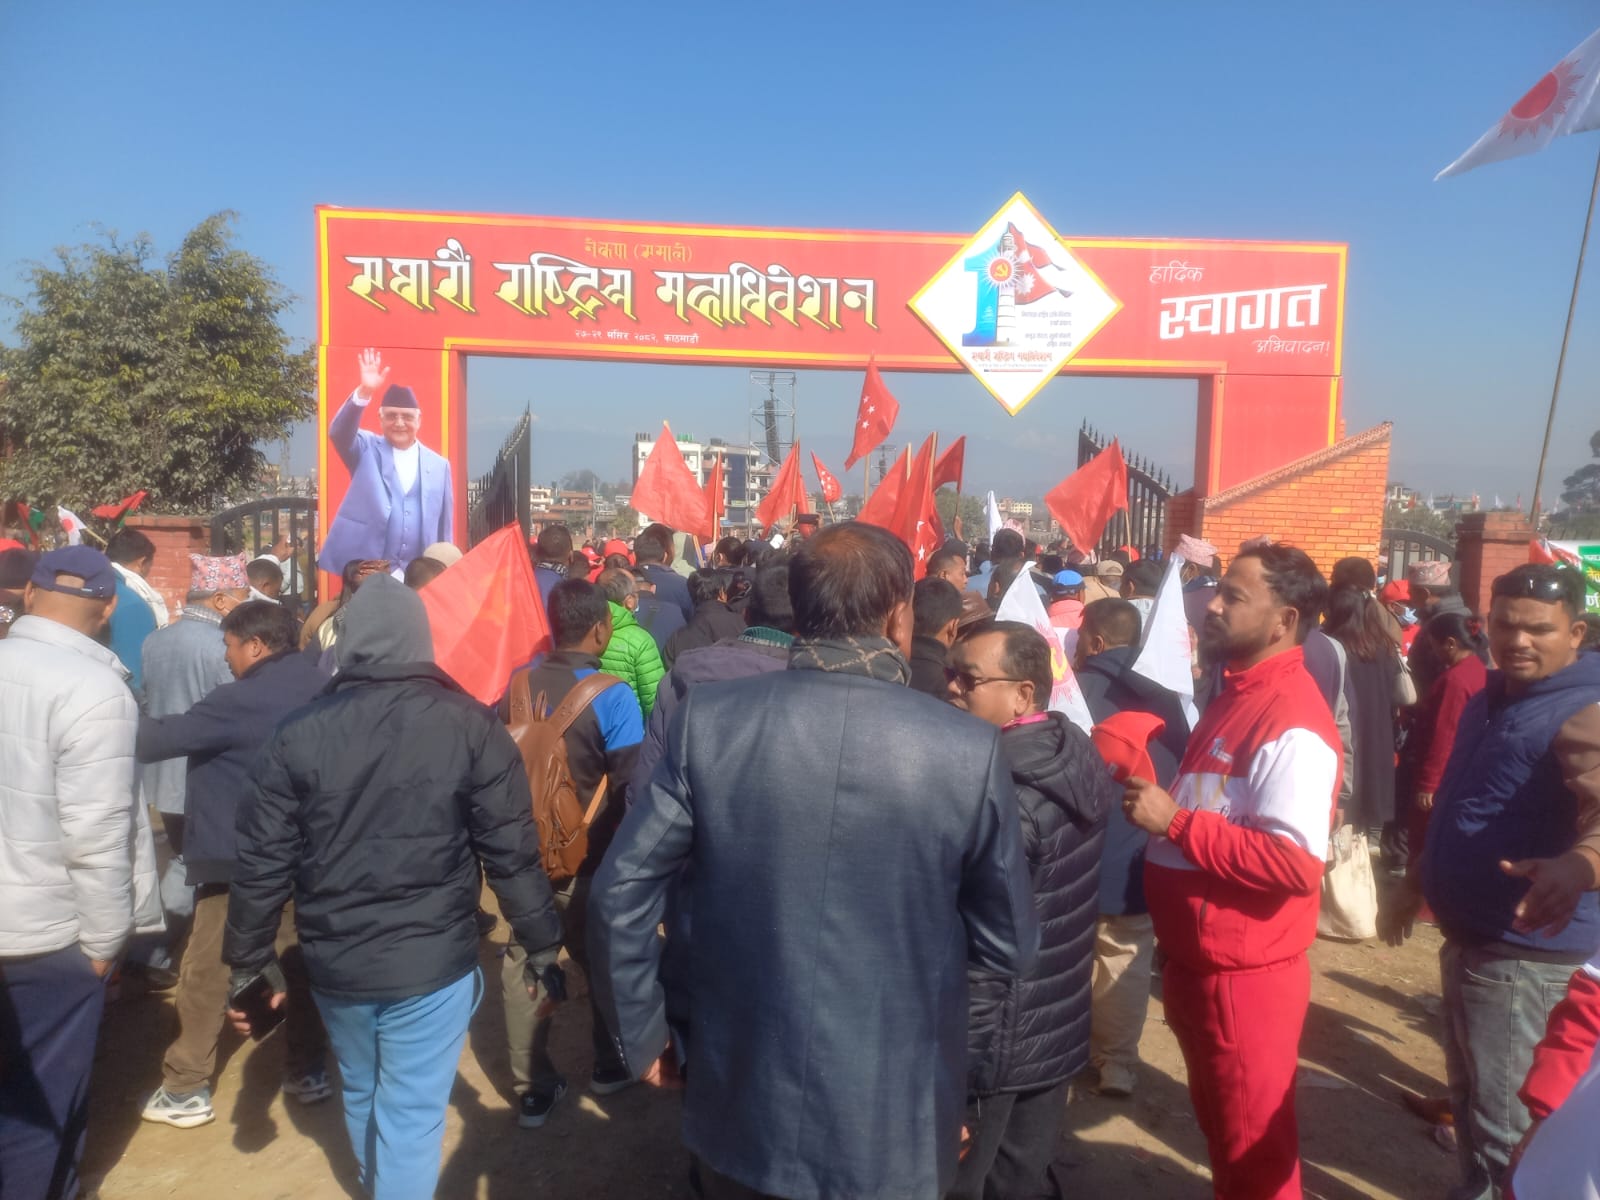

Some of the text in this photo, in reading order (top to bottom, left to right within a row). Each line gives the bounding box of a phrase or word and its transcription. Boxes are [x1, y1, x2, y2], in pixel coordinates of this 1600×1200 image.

[491, 251, 638, 321] राष्ट्रिय
[652, 260, 880, 331] महाधिवेशन
[1149, 260, 1205, 283] हार्दिक
[1159, 283, 1328, 340] स्वागत
